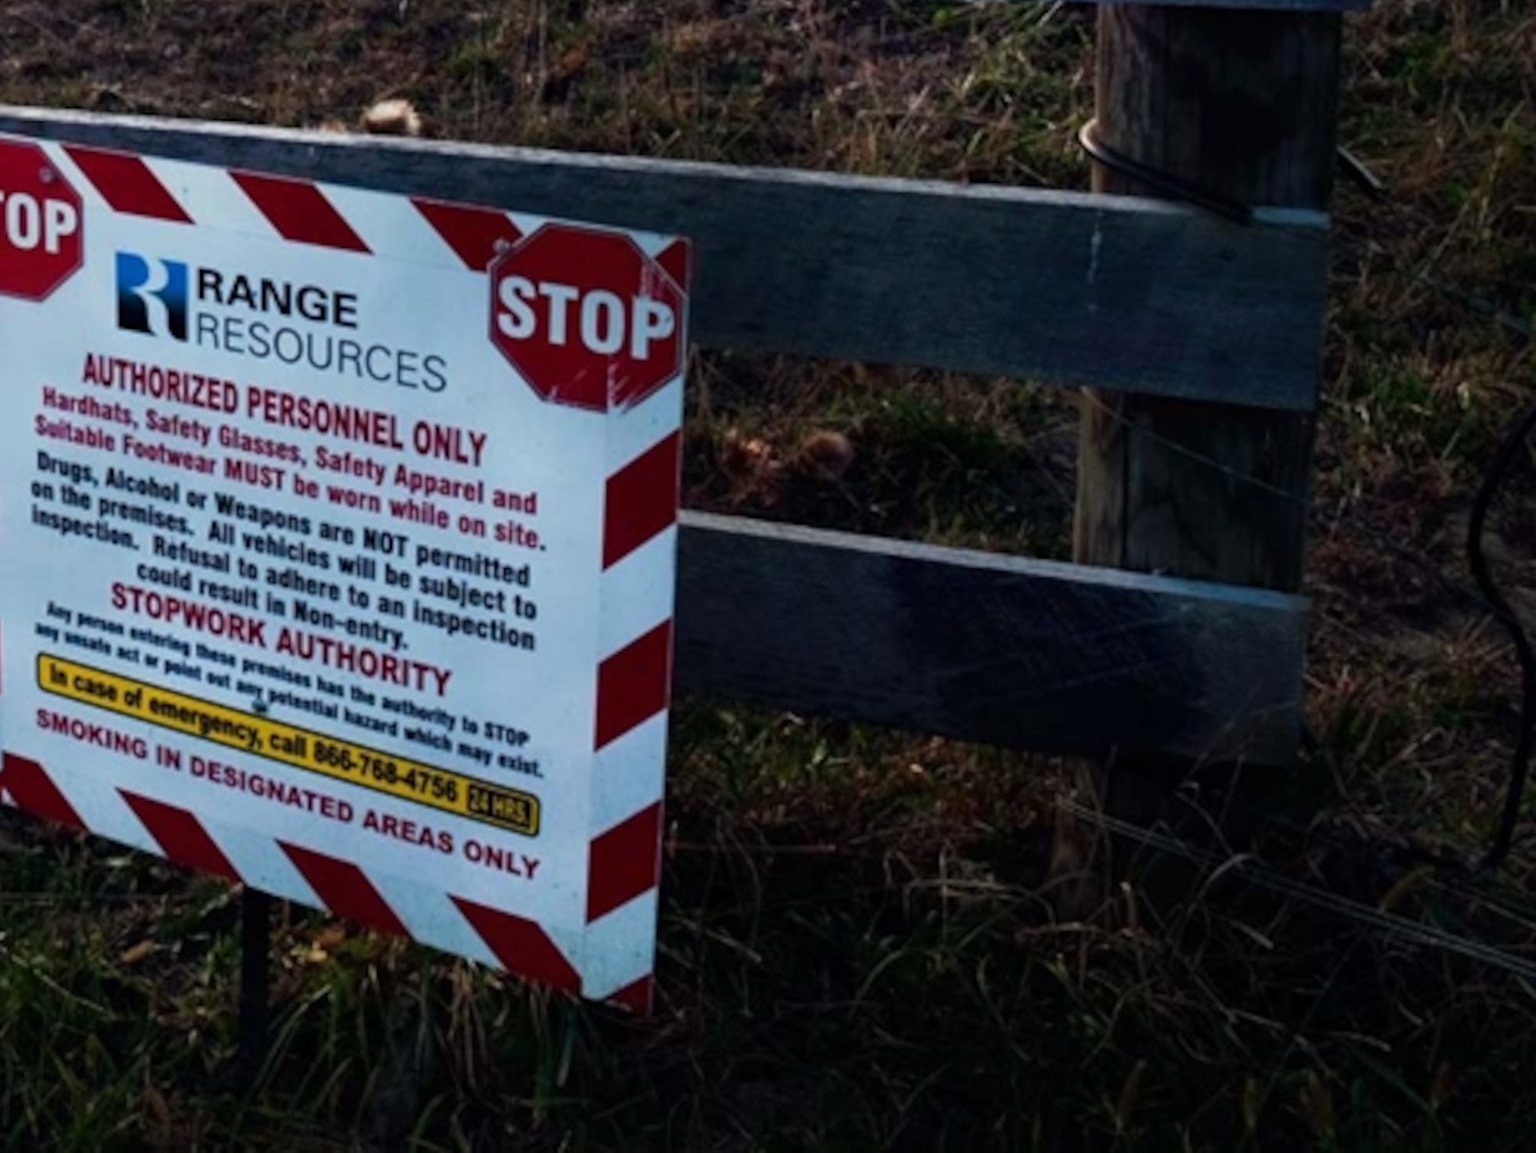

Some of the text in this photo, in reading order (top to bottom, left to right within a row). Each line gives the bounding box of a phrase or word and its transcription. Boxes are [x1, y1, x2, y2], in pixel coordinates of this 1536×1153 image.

[197, 267, 359, 331] RANGE
[197, 312, 447, 393] RESOURCES
[496, 276, 676, 360] STOP
[42, 385, 537, 515] Hardhats, Safety Glasses, Safety Apparel and
[82, 353, 487, 467] AUTHORIZED PERSONNEL ONLY
[31, 481, 537, 620] on the premises. All vehicles will be subject to
[34, 414, 546, 551] Suitable Footwear MUST be worn while on site.
[37, 450, 530, 588] Drugs, Alcohol or Weapons are NOT permitted
[32, 504, 535, 651] inspection. Refusal to adhere to an inspection
[110, 581, 452, 697] STOPWORK AUTHORITY
[136, 563, 408, 651] could result in Non-entry.
[35, 622, 544, 779] any unsafe act or point out any potential hazard which may exist.
[46, 601, 530, 747] Any person entering these premises has the authority to STOP
[50, 663, 67, 685] In
[72, 674, 117, 701] case
[124, 688, 142, 707] of
[149, 696, 263, 750] emergency,
[270, 729, 307, 758] call
[313, 740, 459, 802] 866-768-4756
[469, 784, 491, 815] 24
[36, 708, 540, 880] SMOKING IN DESIGNATED AREAS ONLY
